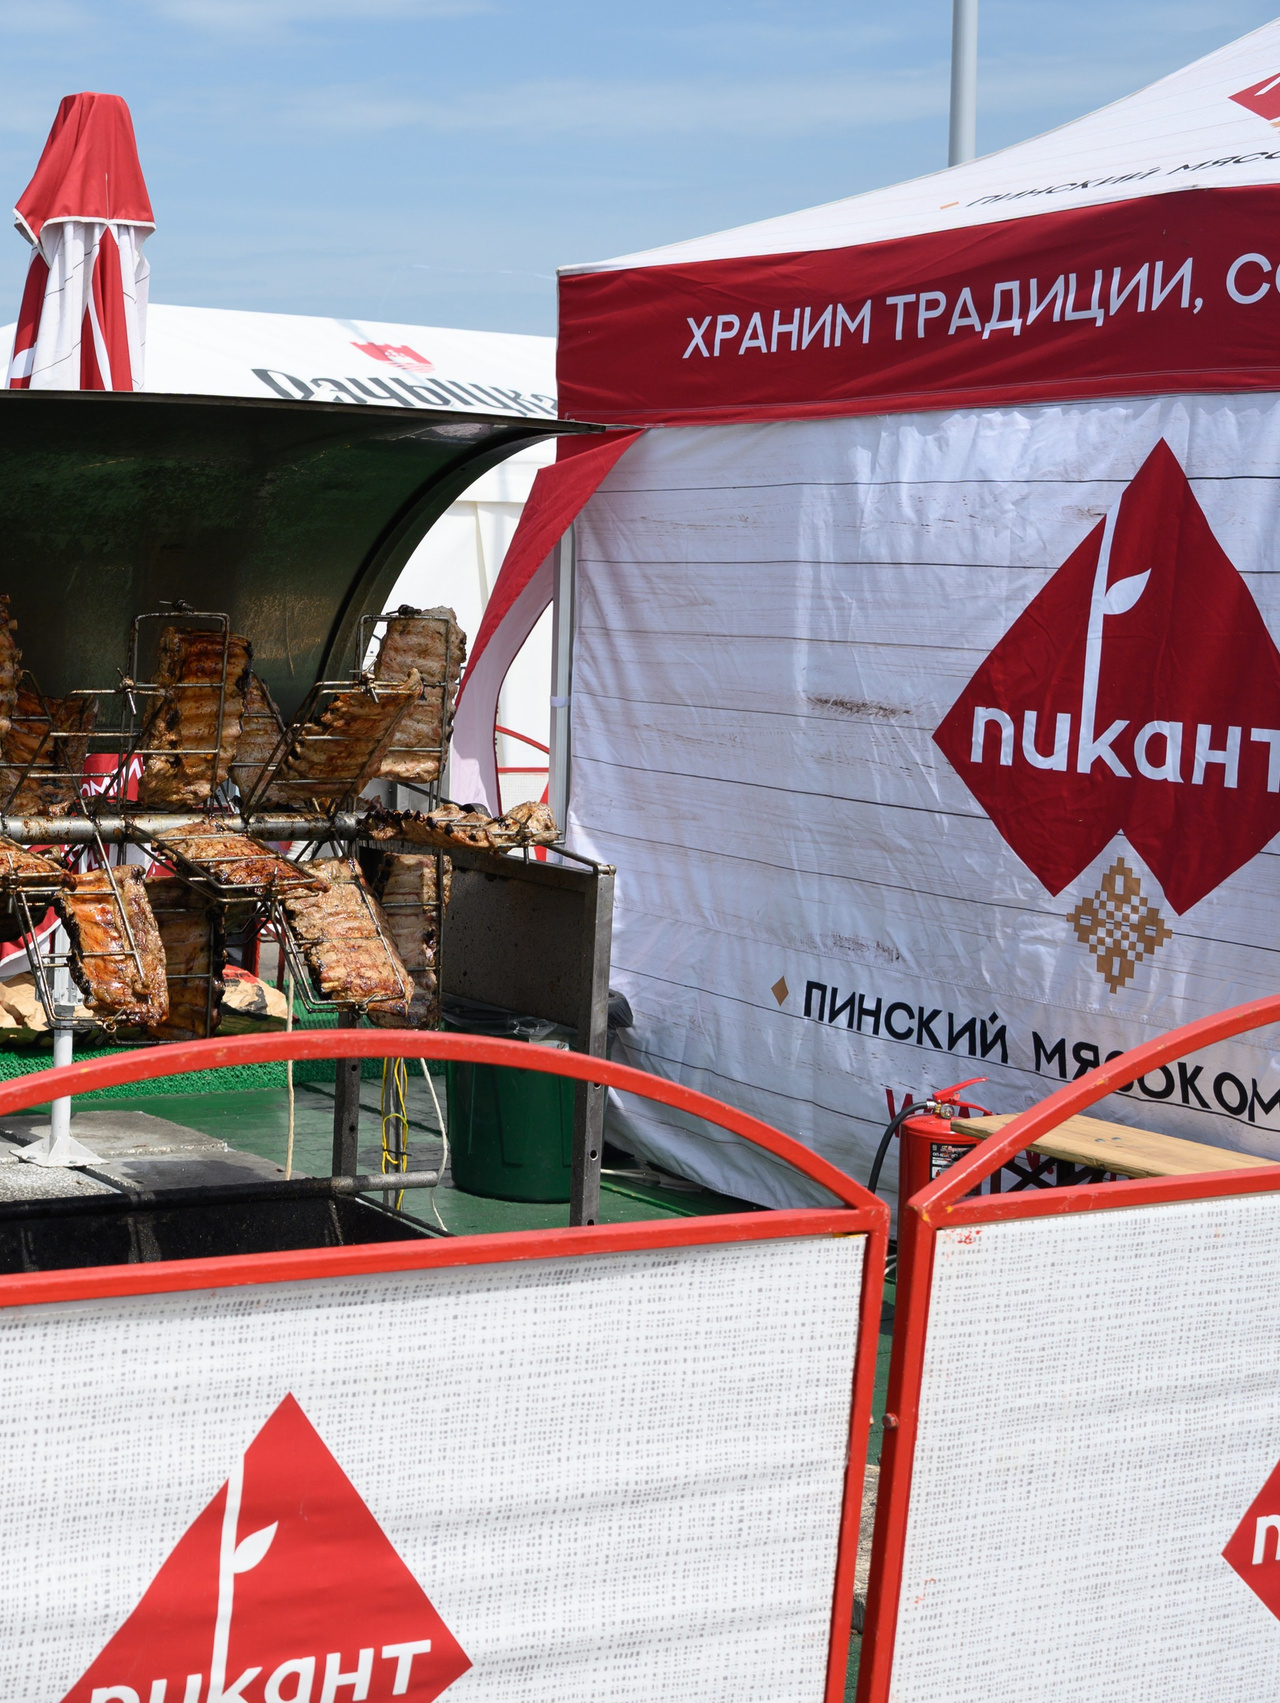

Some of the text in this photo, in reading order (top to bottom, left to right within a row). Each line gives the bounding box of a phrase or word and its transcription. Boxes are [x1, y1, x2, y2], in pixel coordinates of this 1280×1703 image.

[966, 167, 1160, 207] ПИНСКИЙ
[683, 252, 1280, 359] ХРАНИМ ТРАДИЦИИ, С
[803, 981, 1008, 1064] ПИНСКИЙ
